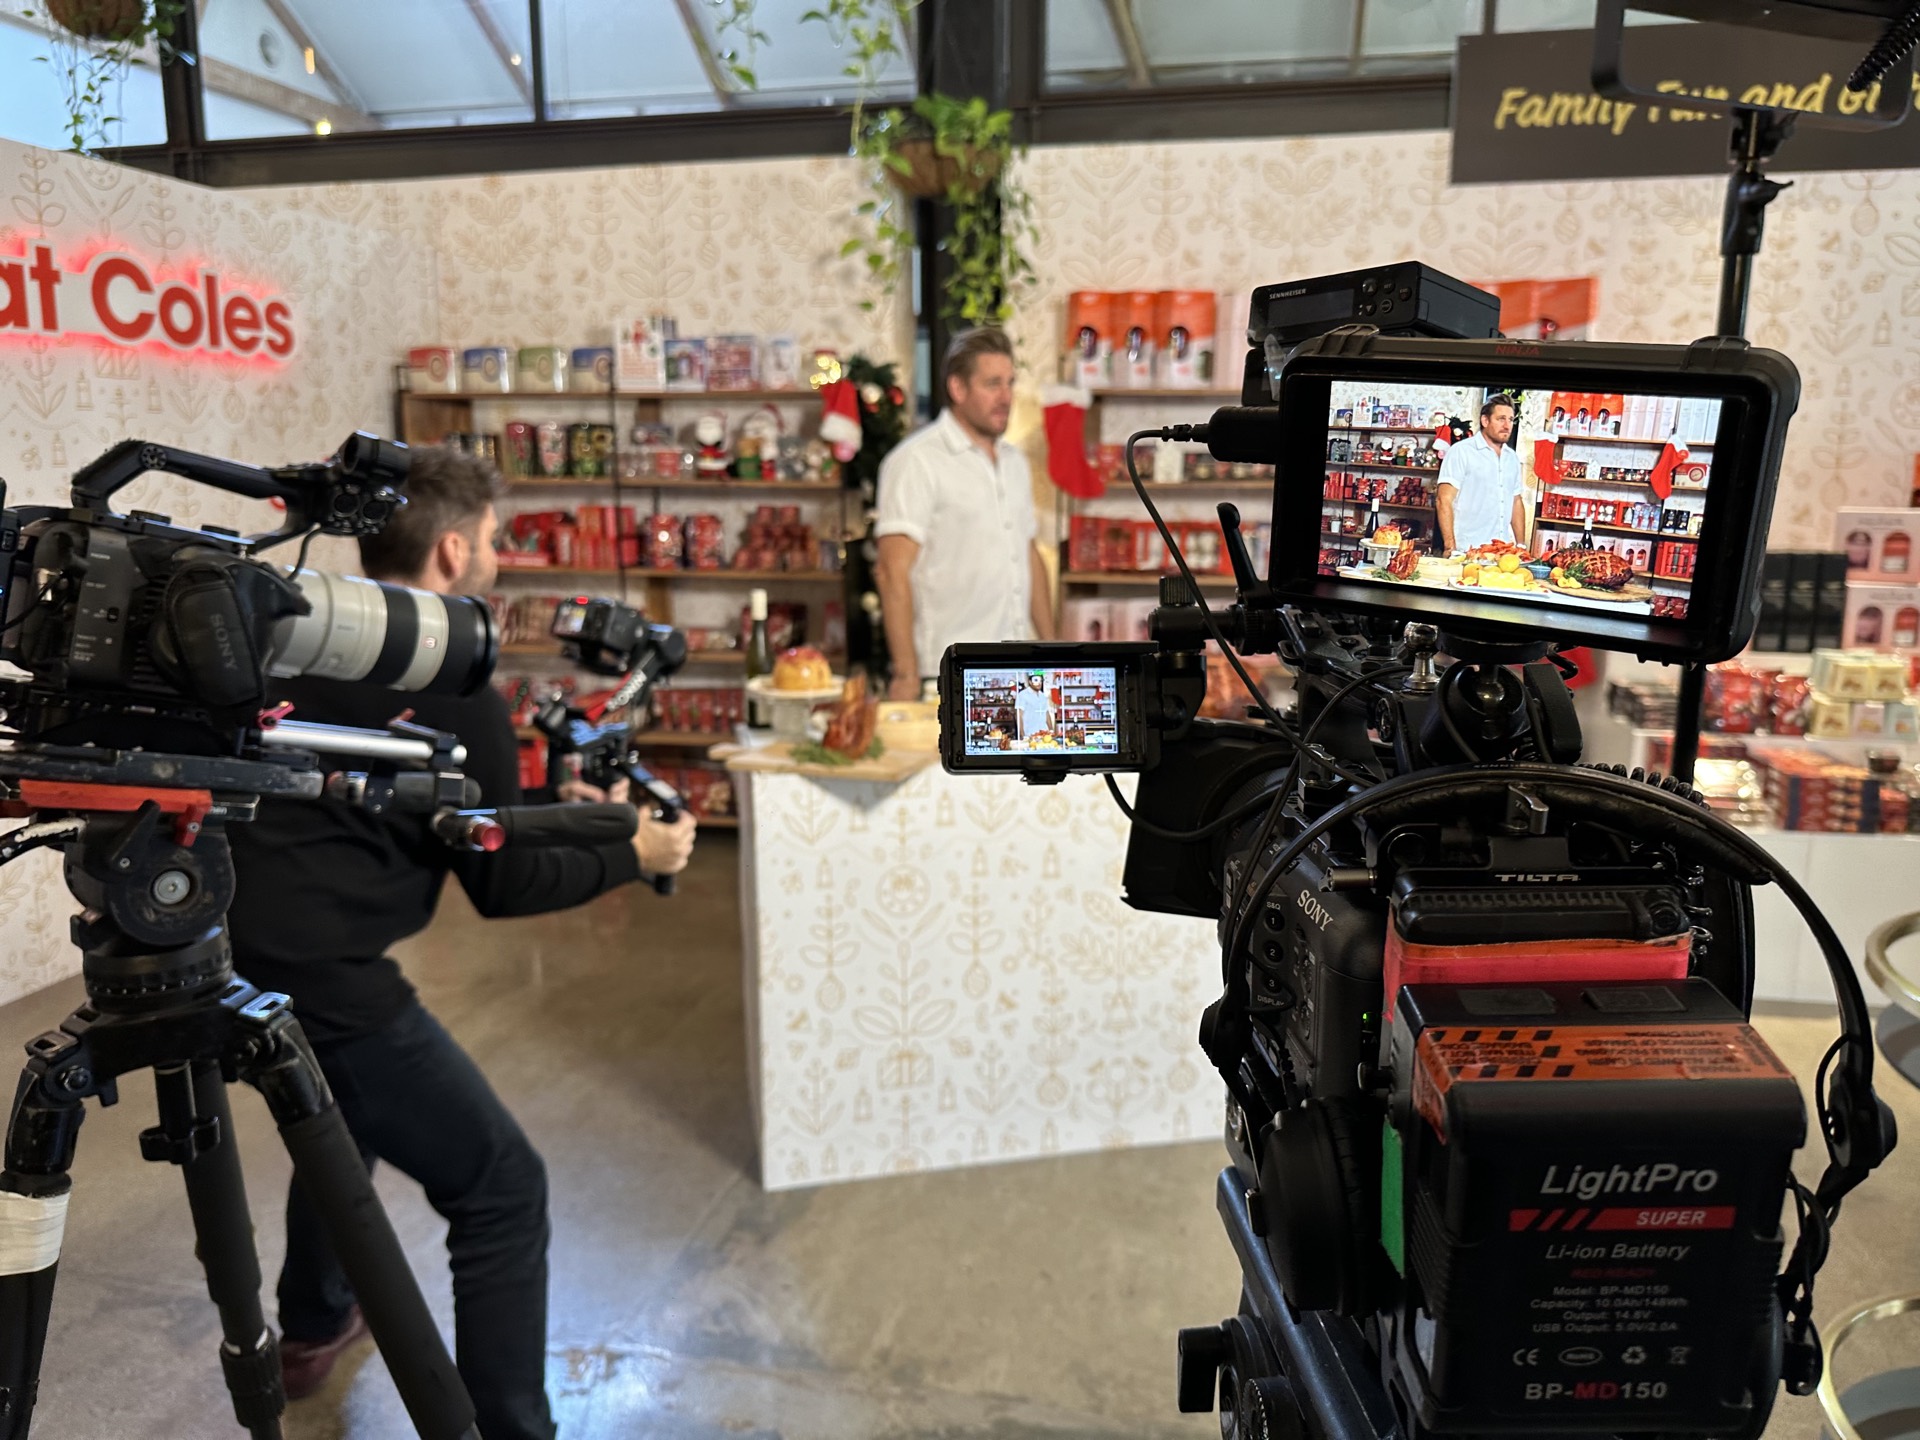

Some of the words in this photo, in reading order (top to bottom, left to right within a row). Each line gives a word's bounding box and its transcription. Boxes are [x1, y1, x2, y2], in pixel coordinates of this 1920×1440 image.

[1739, 73, 1832, 113] and
[1269, 288, 1307, 300] SENNHEISER
[91, 258, 295, 355] Coles
[1495, 344, 1540, 356] NINJA
[210, 613, 238, 670] SONY
[1494, 873, 1579, 882] TILTA
[1297, 890, 1334, 931] SONY
[1540, 1163, 1718, 1200] LightPro
[1635, 1210, 1707, 1226] SUPER
[1545, 1244, 1604, 1259] Li-ion
[1611, 1243, 1691, 1261] Battery
[1532, 1323, 1560, 1333] USB
[1525, 1381, 1668, 1400] BP-MD150
